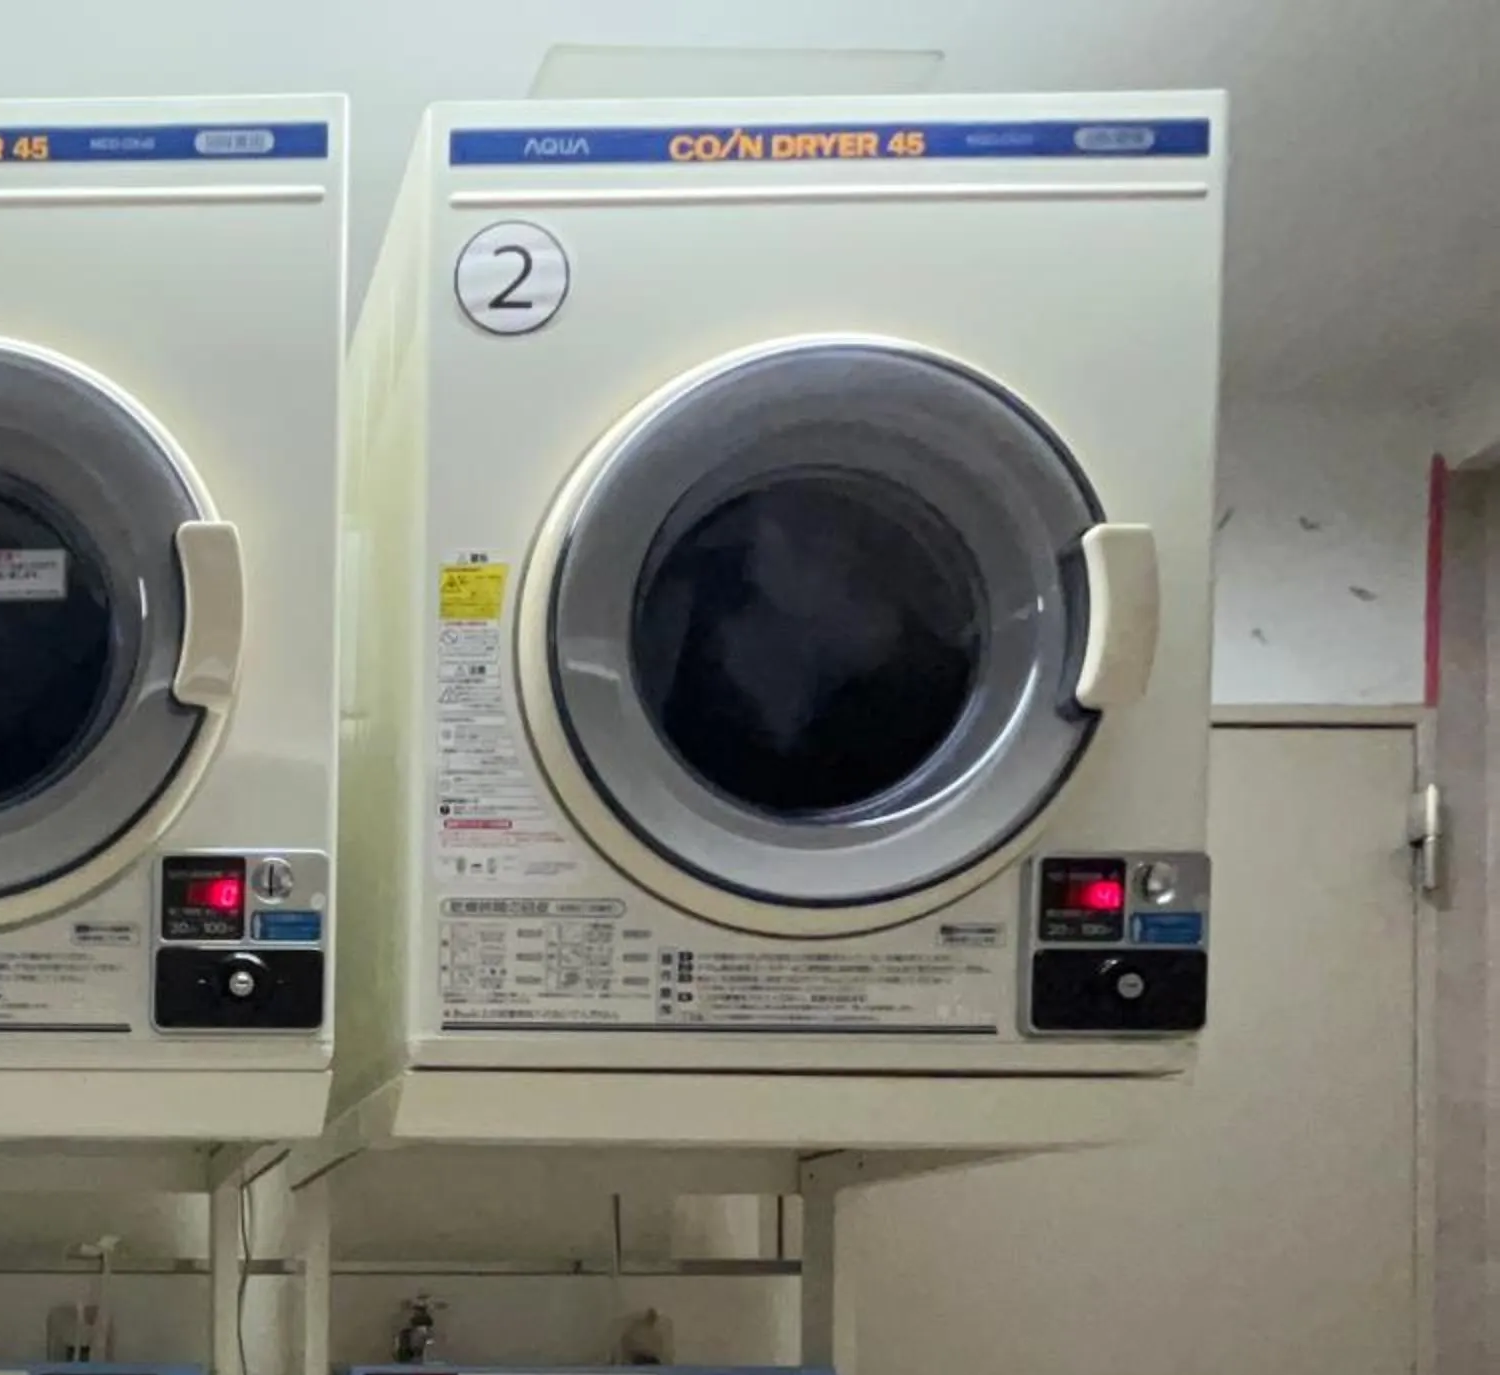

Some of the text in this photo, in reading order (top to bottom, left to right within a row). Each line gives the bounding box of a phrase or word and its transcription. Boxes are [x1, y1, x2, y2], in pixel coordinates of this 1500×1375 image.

[13, 136, 48, 160] 45
[523, 136, 590, 156] AQUA
[772, 132, 879, 159] DRYER
[887, 131, 925, 156] 45
